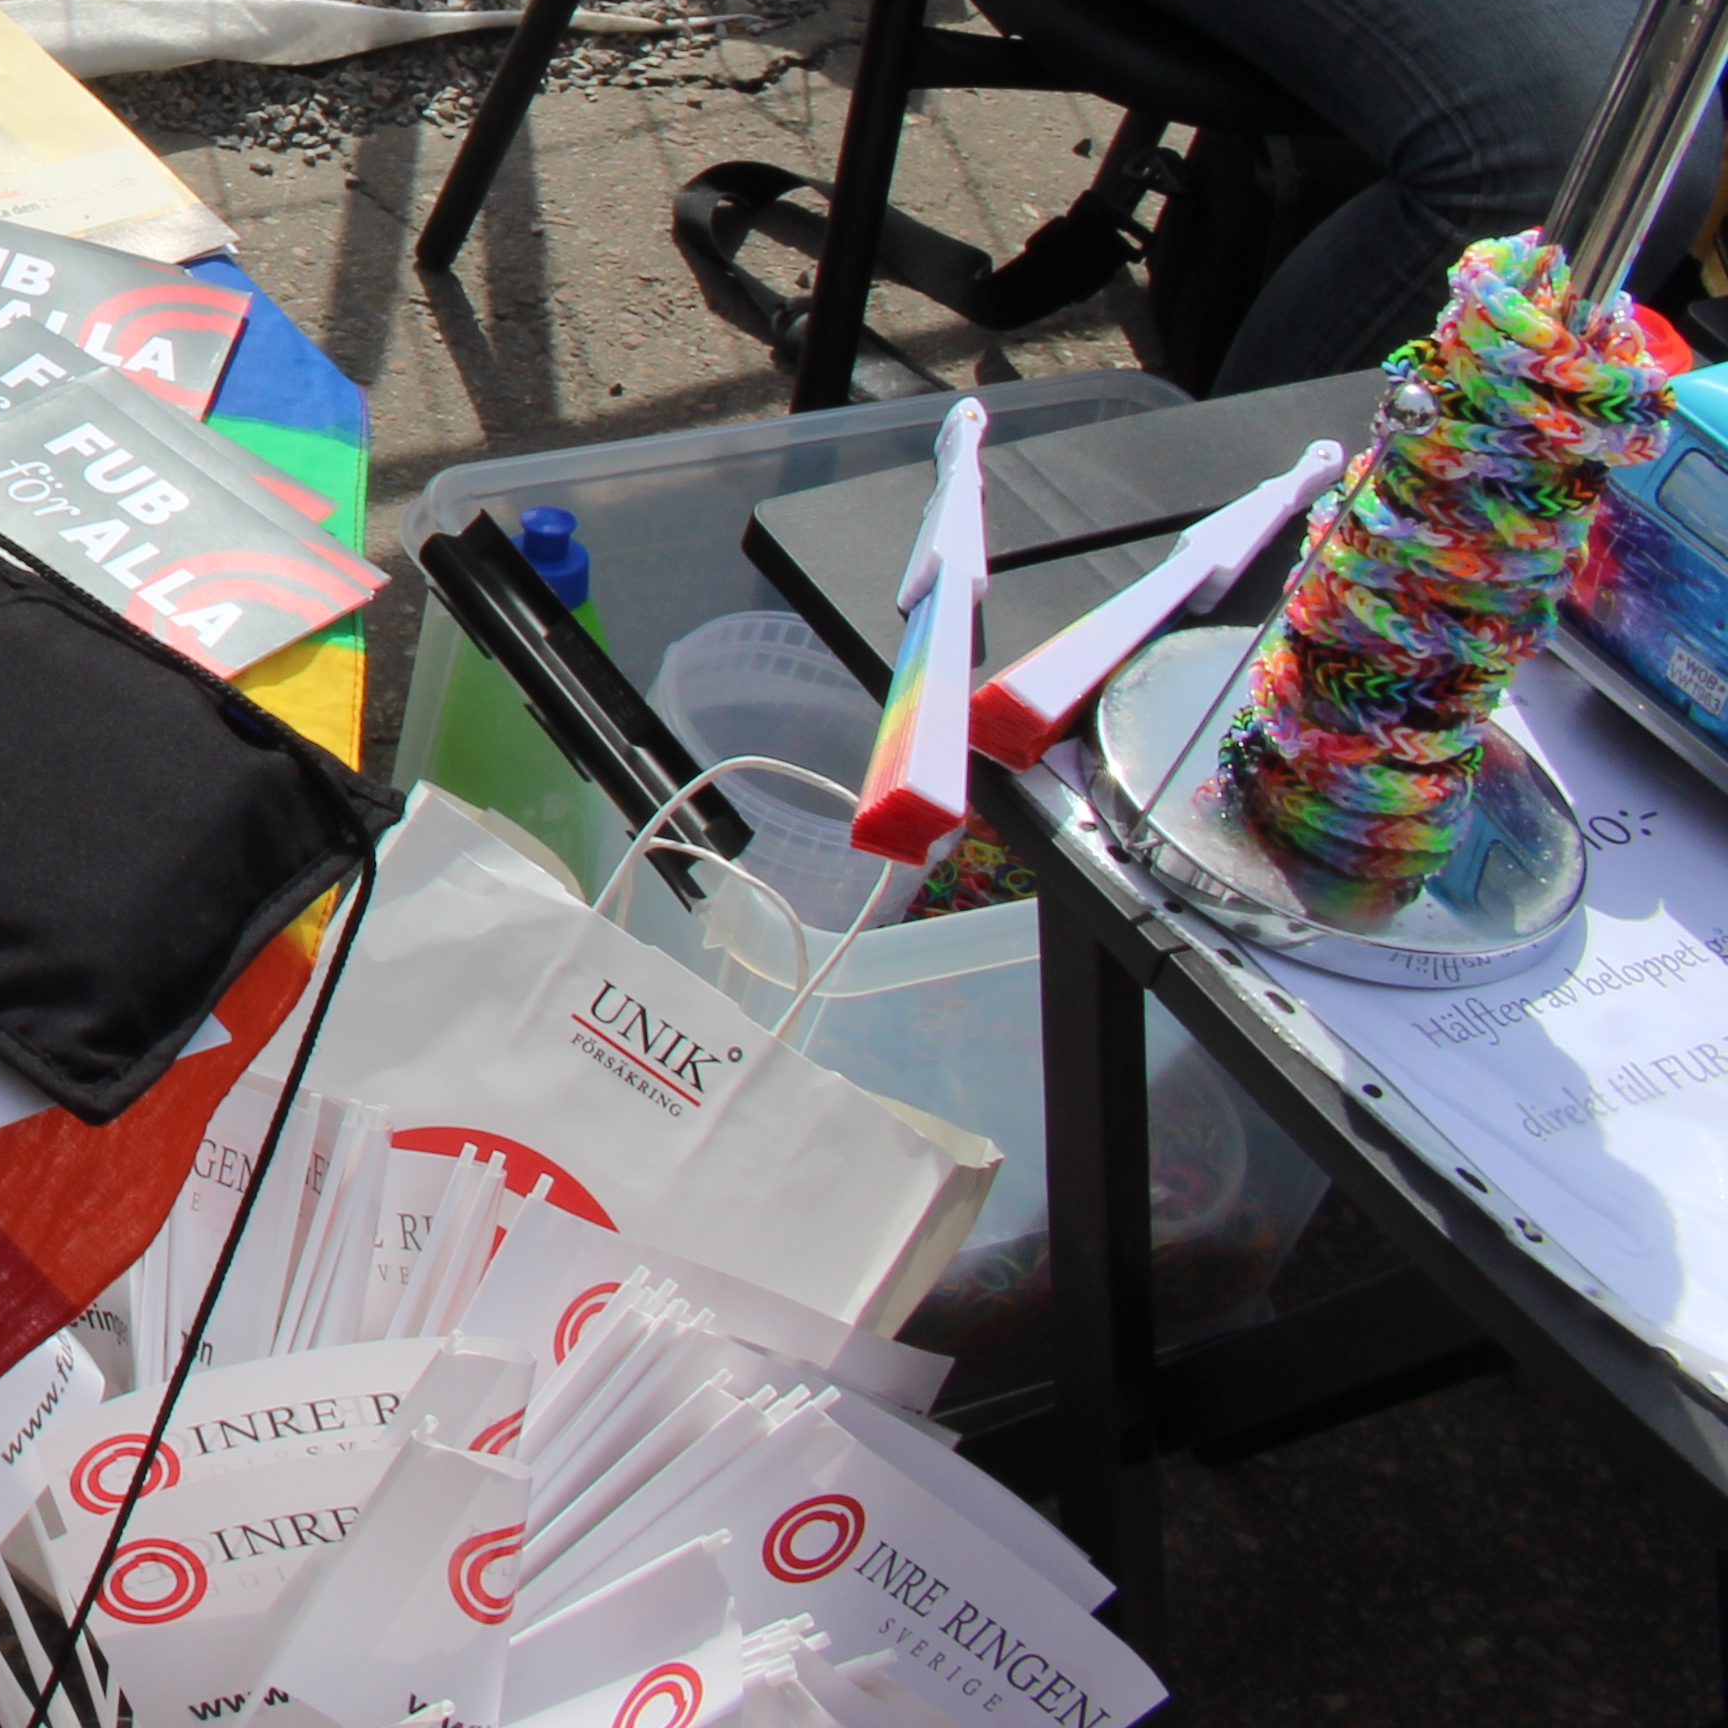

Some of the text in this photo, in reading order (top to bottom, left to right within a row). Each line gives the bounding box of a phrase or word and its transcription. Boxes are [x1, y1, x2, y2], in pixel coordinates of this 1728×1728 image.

[44, 422, 191, 526] FUB
[61, 516, 247, 649] ALLA
[591, 979, 722, 1094] UNIK
[1411, 997, 1544, 1049] Hälften
[1541, 967, 1578, 1010] av
[1581, 939, 1709, 996] beloppet
[570, 1033, 683, 1118] FÖRSÄKRING
[1516, 1086, 1619, 1141] direkt
[1608, 1062, 1666, 1105] till
[187, 1396, 344, 1456] INRE
[853, 1540, 1111, 1728] INRE RINGEN
[879, 1617, 1003, 1712] SVERIGE
